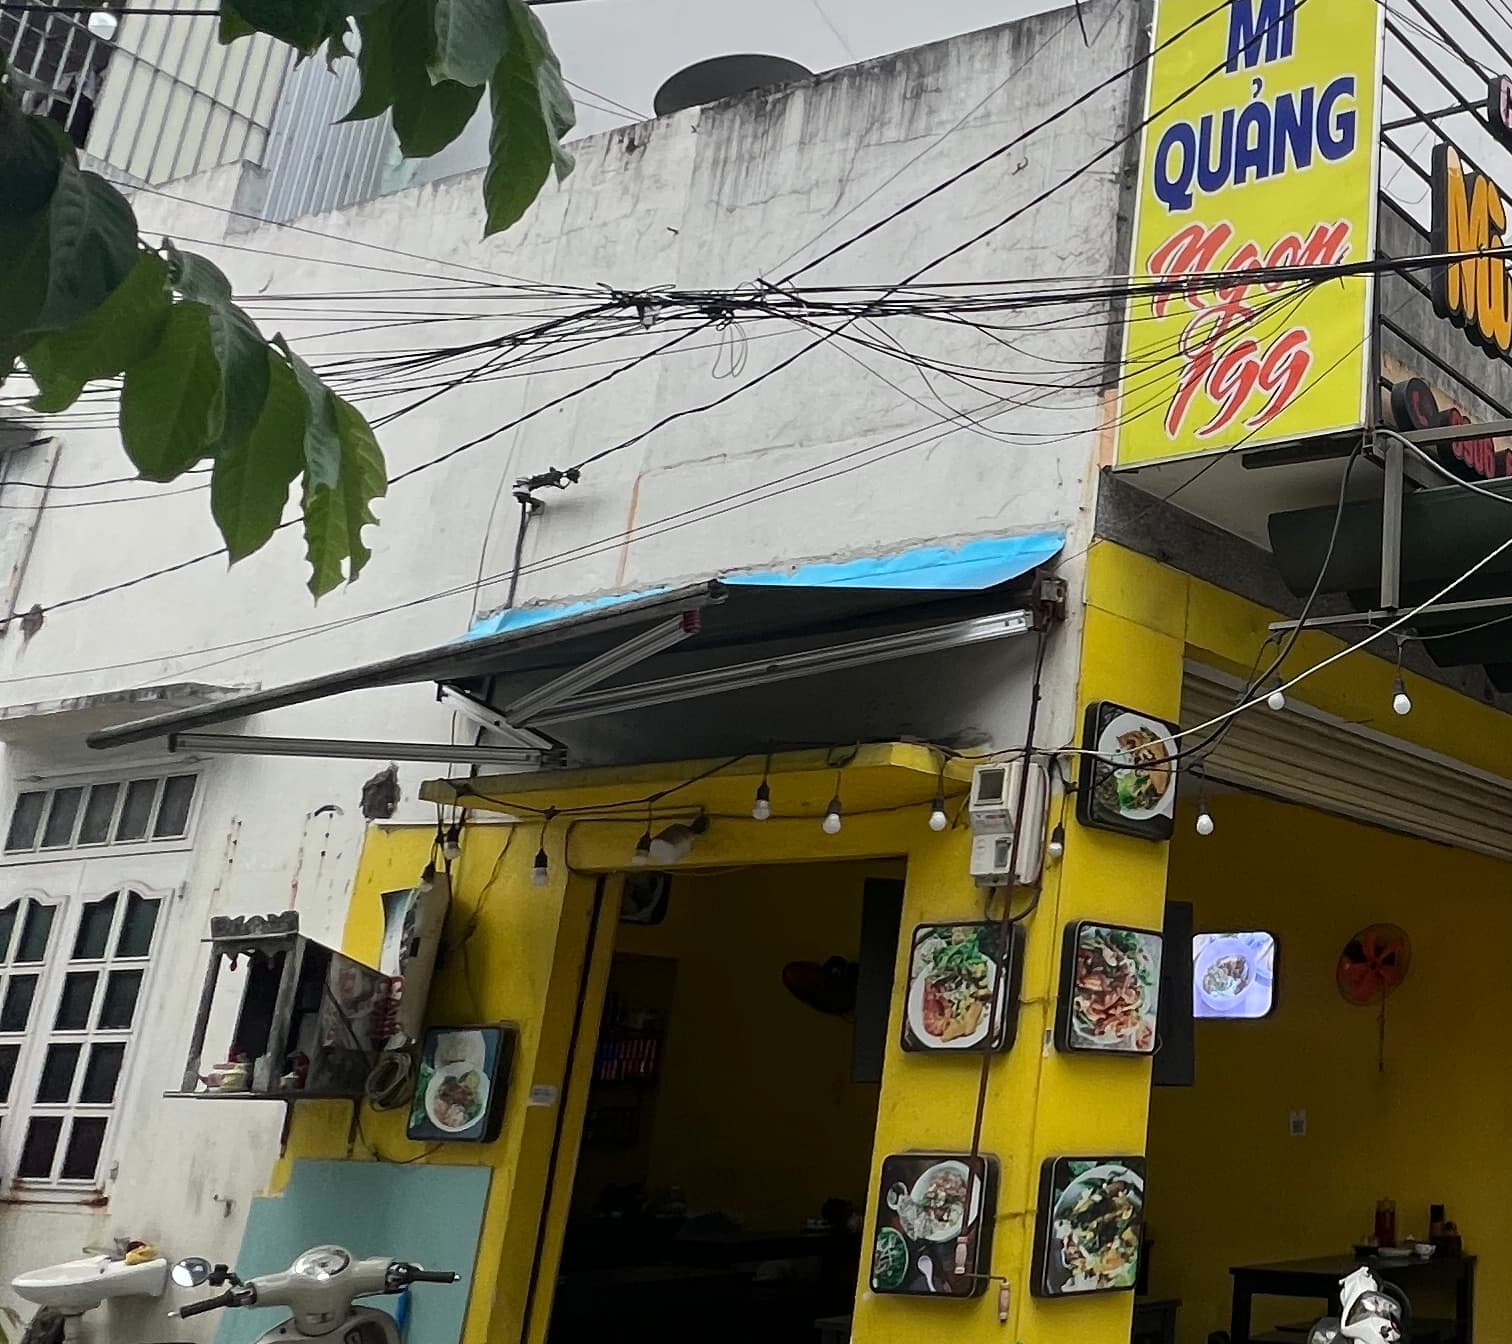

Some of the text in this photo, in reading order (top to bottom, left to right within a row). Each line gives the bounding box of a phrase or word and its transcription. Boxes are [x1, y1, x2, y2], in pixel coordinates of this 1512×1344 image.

[1154, 77, 1356, 213] QUẢNG
[1148, 222, 1350, 360] Ngon
[1165, 329, 1310, 437] 199
